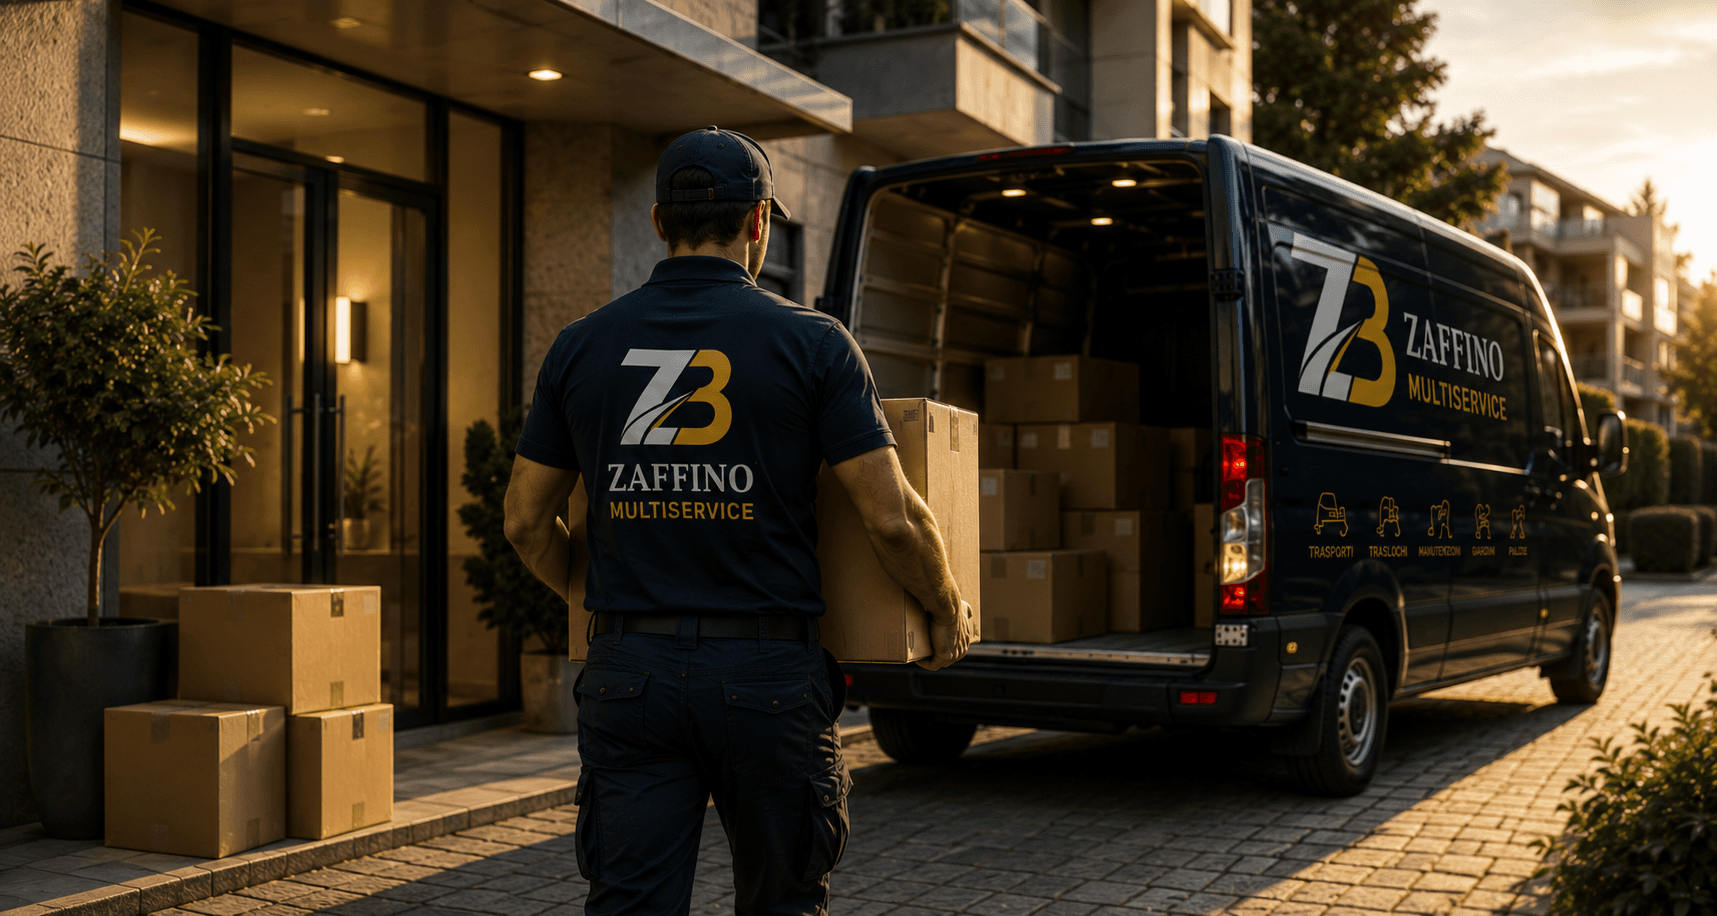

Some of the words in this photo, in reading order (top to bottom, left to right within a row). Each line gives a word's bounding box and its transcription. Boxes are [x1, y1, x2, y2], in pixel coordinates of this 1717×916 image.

[1403, 311, 1505, 381] ZAFFINO
[1408, 373, 1507, 421] MULTISERVICE
[608, 463, 754, 493] ZAFFINO
[610, 501, 754, 520] MULTISERVICE
[1308, 545, 1354, 558] TRASPORTI
[1368, 545, 1408, 558] TRASLOCHI
